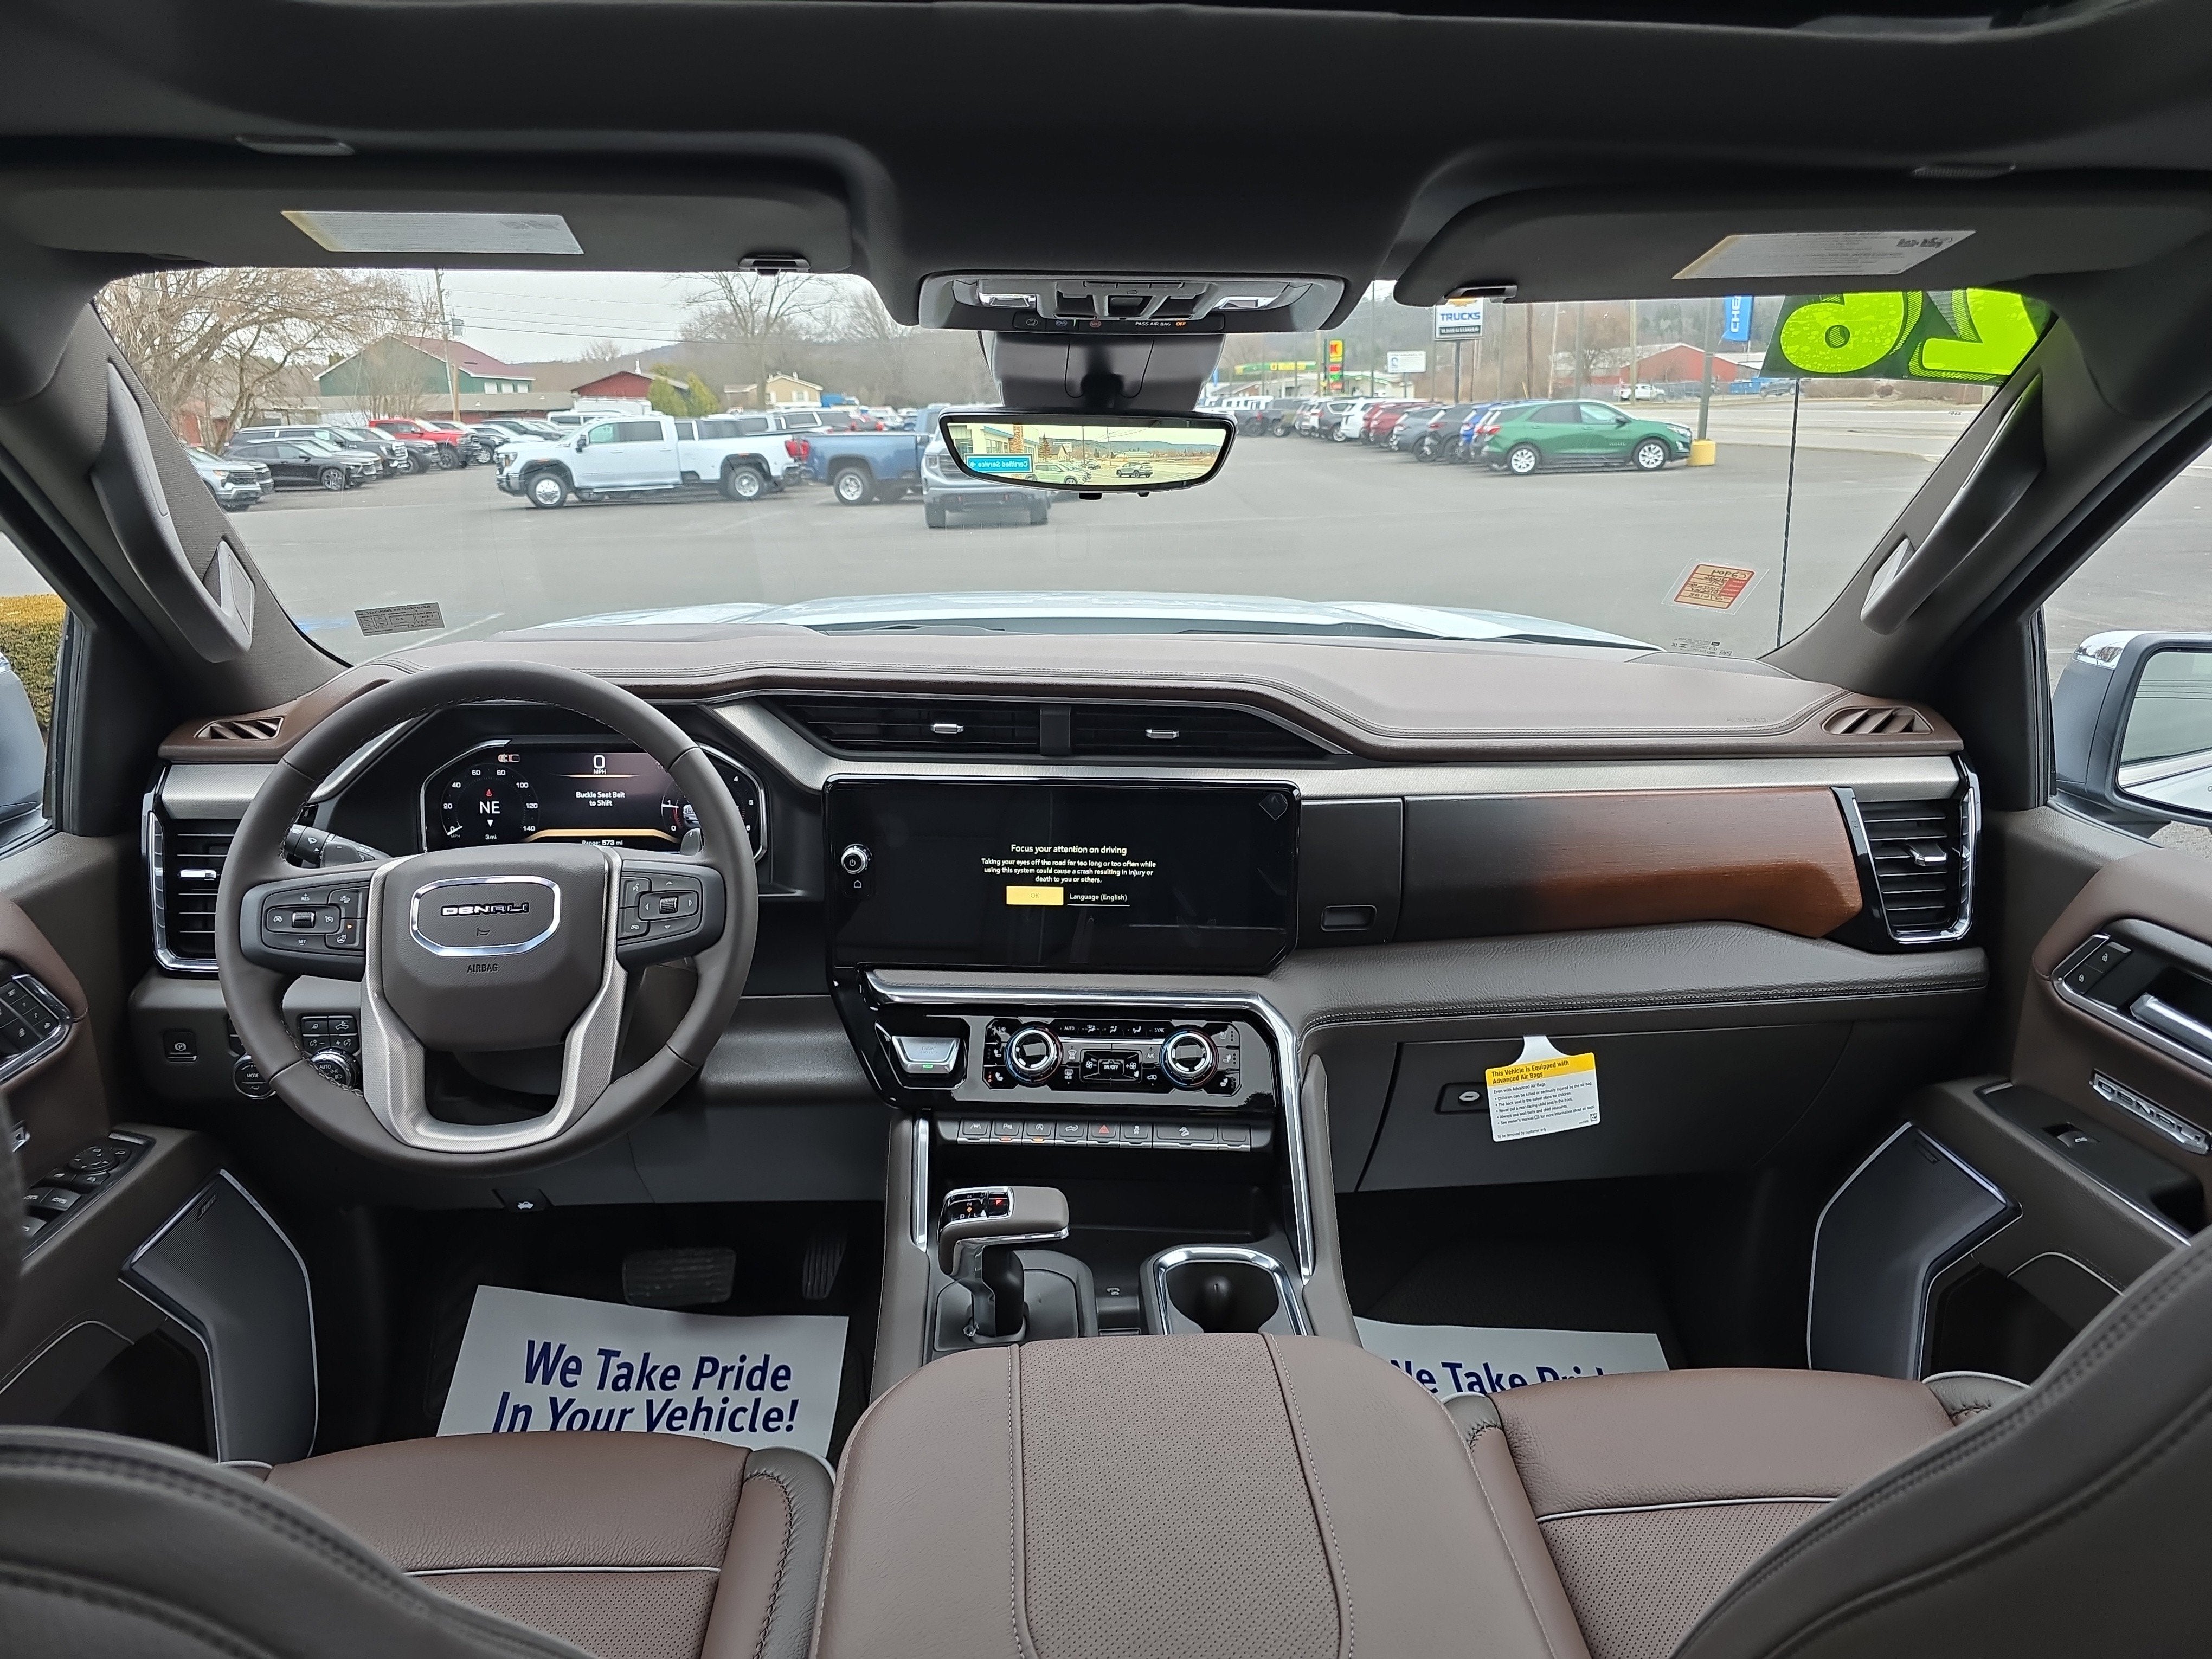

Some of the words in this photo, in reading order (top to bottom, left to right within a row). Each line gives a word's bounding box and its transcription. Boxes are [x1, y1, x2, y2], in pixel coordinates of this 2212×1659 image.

[1441, 312, 1480, 321] TRUCKS
[593, 755, 605, 769] 0
[479, 801, 500, 814] NE
[1011, 844, 1033, 853] Focus
[1035, 846, 1052, 854] your
[1053, 845, 1088, 853] attention
[1101, 846, 1127, 856] driving
[1094, 869, 1121, 877] resulting
[1100, 893, 1128, 902] (English)
[441, 903, 529, 916] DENALI
[467, 963, 498, 973] AIRBAG
[1532, 1062, 1556, 1071] Equipped
[1493, 1075, 1519, 1084] Advanced
[524, 1340, 582, 1388] We
[596, 1348, 681, 1392] Take
[692, 1354, 791, 1392] Pride
[1441, 1361, 1527, 1393] Take
[492, 1392, 530, 1433] In
[548, 1397, 635, 1432] Your
[646, 1397, 799, 1433] Vehicle!
